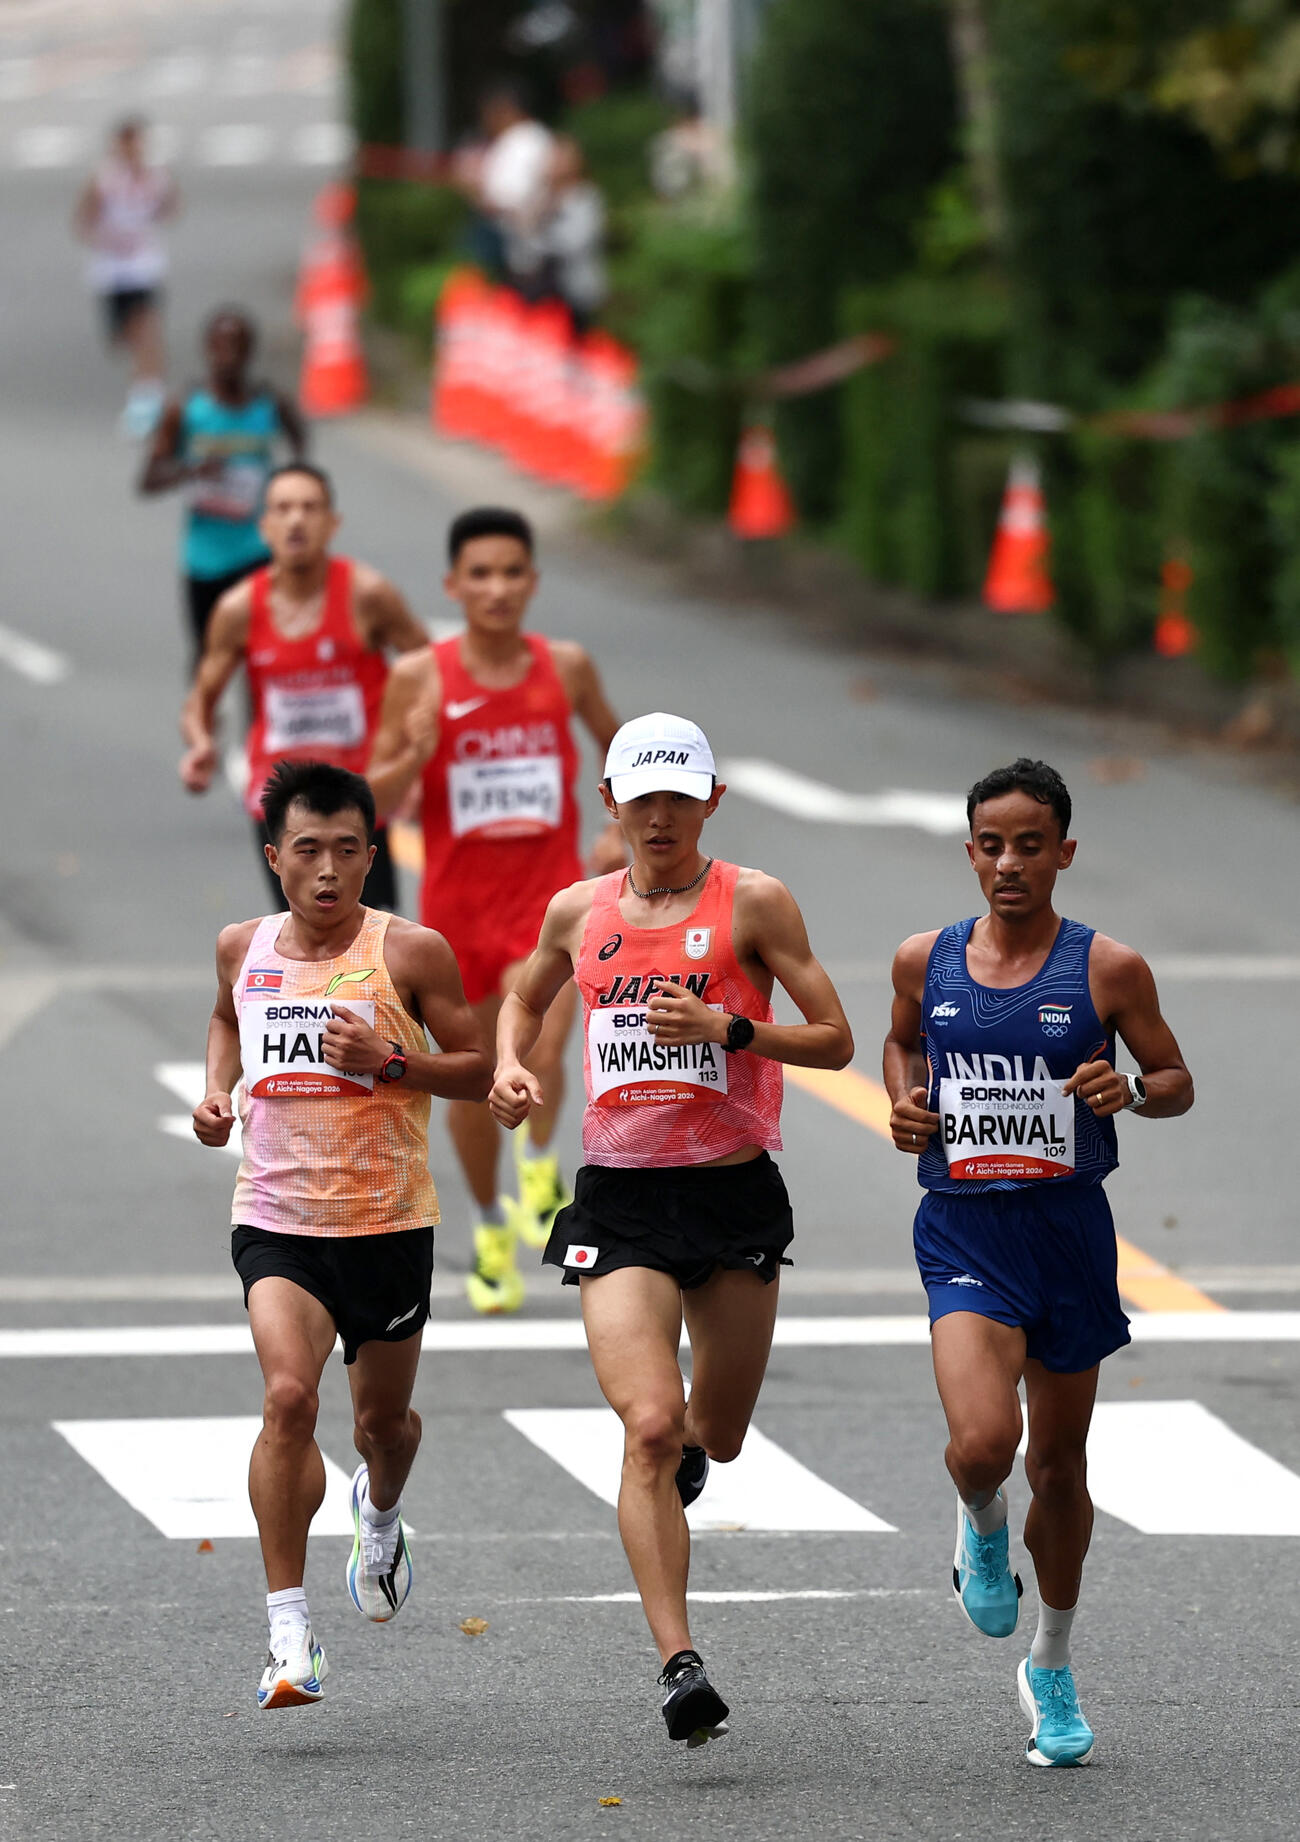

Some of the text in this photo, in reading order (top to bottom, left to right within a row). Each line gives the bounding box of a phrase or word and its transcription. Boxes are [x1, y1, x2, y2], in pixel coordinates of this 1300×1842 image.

[631, 750, 689, 768] JAPAN
[930, 1006, 960, 1018] JSW
[1039, 1012, 1071, 1024] INDIA
[266, 1021, 291, 1029] SPORTS
[614, 1029, 641, 1037] SPORTS
[945, 1052, 1054, 1081] INDIA
[698, 1071, 718, 1082] 113
[960, 1087, 1045, 1101] BORNAN
[961, 1102, 1044, 1110] SPORTS TECHNOLOGY
[944, 1113, 1065, 1145] BARWAL
[1043, 1146, 1066, 1157] 109
